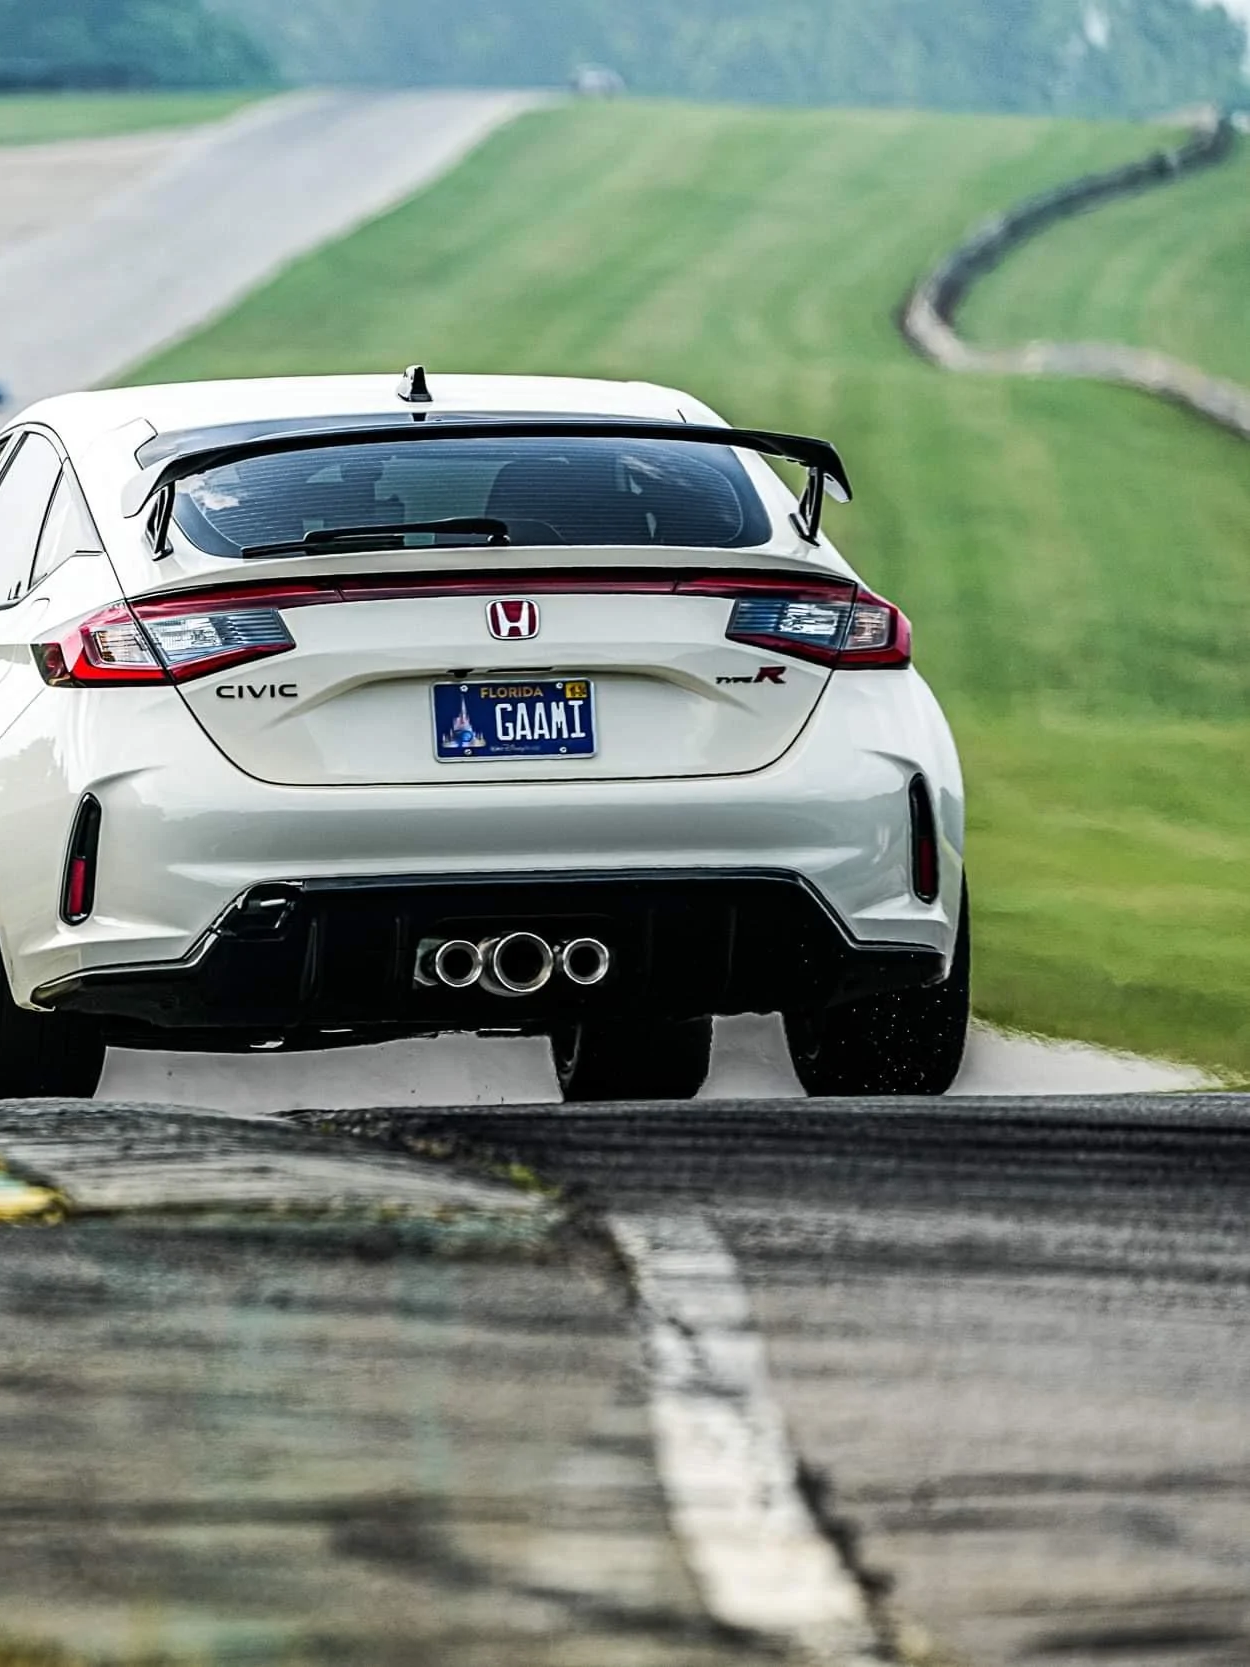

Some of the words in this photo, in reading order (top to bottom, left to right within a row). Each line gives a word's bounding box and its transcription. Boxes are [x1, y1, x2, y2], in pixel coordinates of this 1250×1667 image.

[216, 684, 298, 699] CIVIC
[480, 687, 543, 698] FLORIDA
[495, 700, 586, 741] GAAMI
